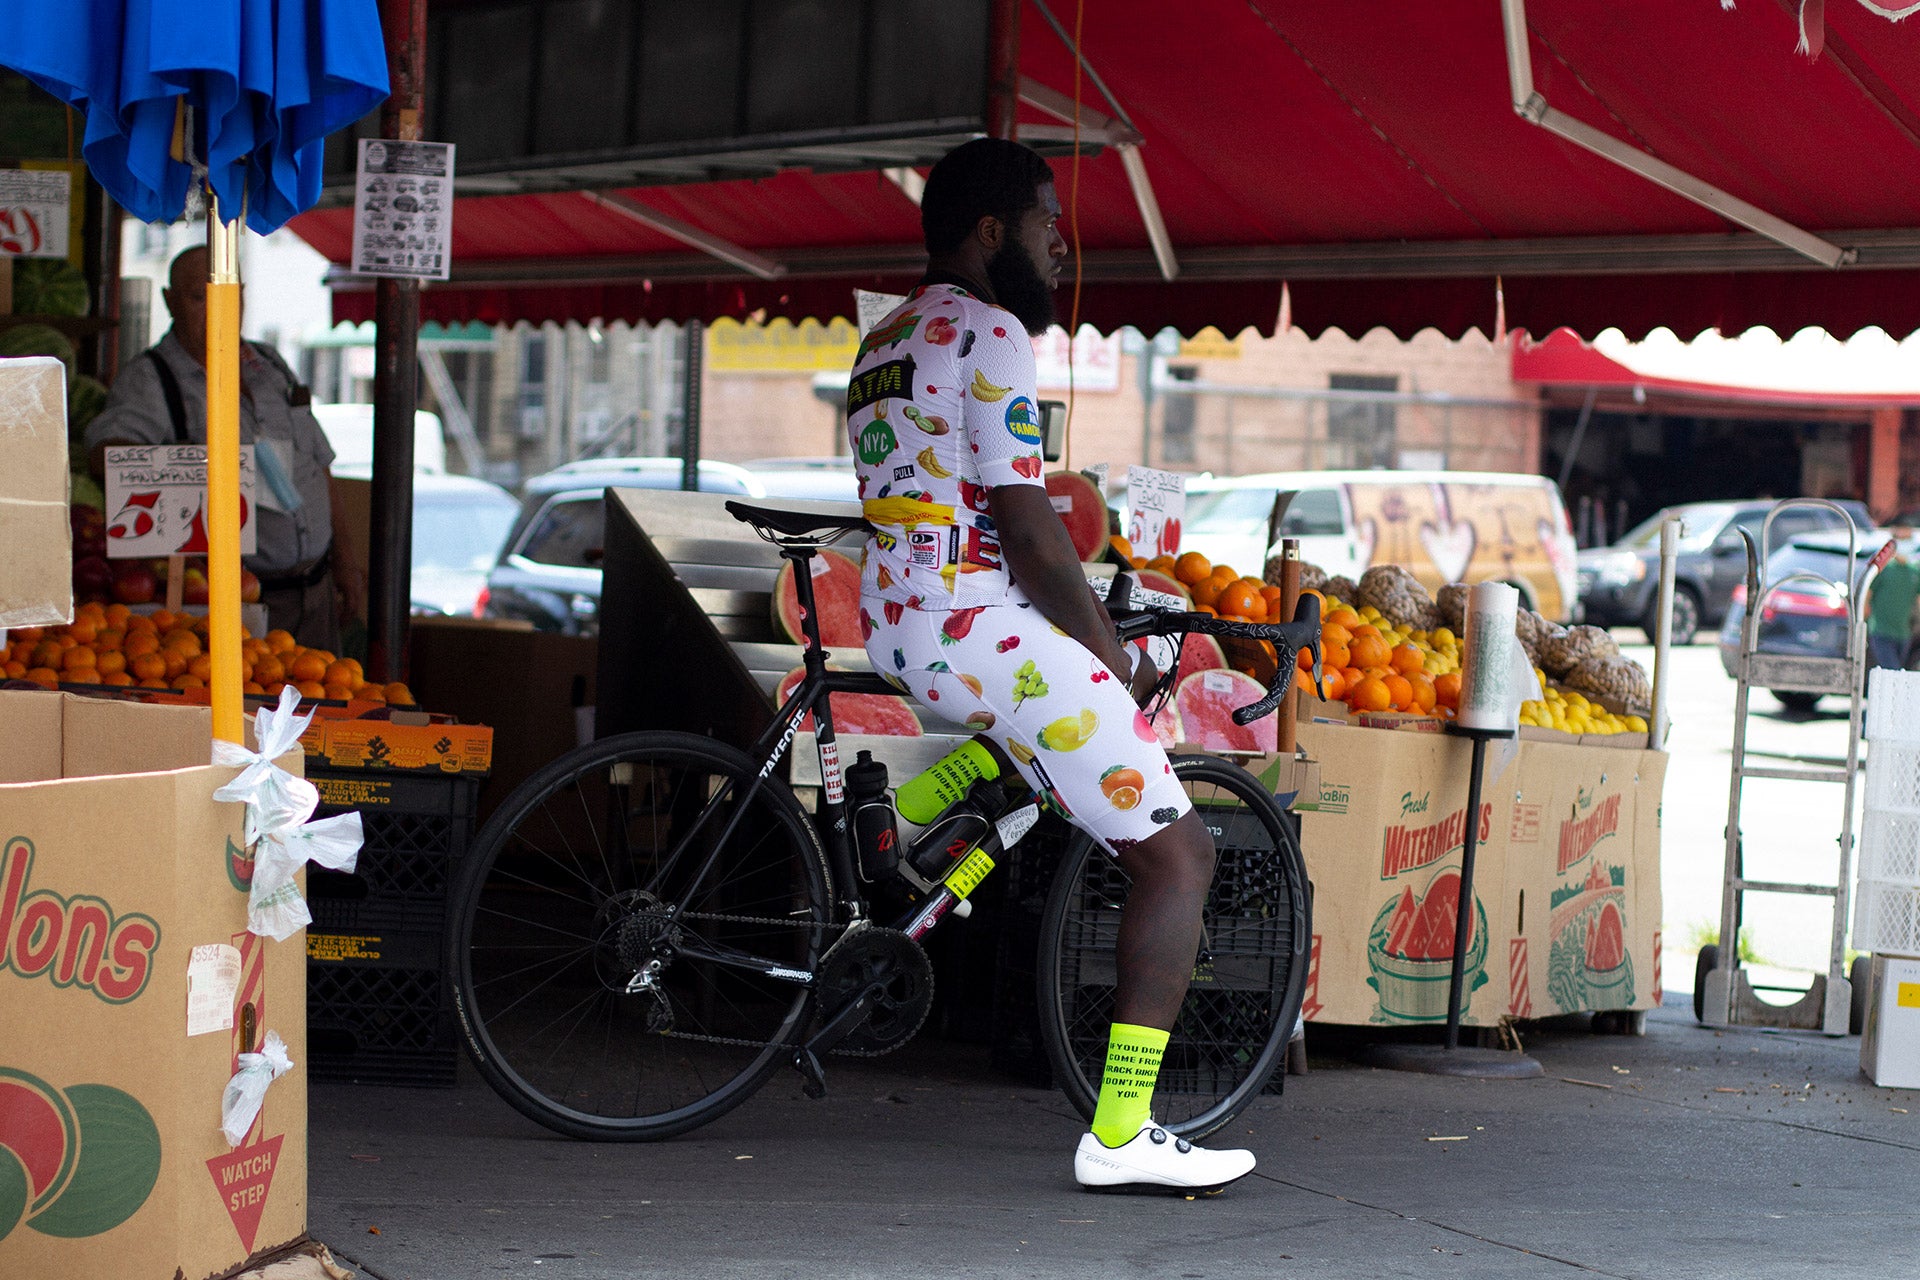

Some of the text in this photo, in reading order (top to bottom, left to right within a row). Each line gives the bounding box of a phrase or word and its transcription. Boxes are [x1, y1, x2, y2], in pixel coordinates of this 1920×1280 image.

[848, 365, 901, 404] ATM
[864, 432, 888, 454] NYC
[894, 466, 914, 480] PULL
[107, 490, 161, 540] 5
[758, 708, 806, 778] TAKEOFF
[1400, 791, 1430, 818] Fresh
[1109, 1053, 1136, 1063] COME
[1116, 1043, 1139, 1052] YOU
[222, 1151, 272, 1186] WATCH
[230, 1183, 265, 1212] STEP
